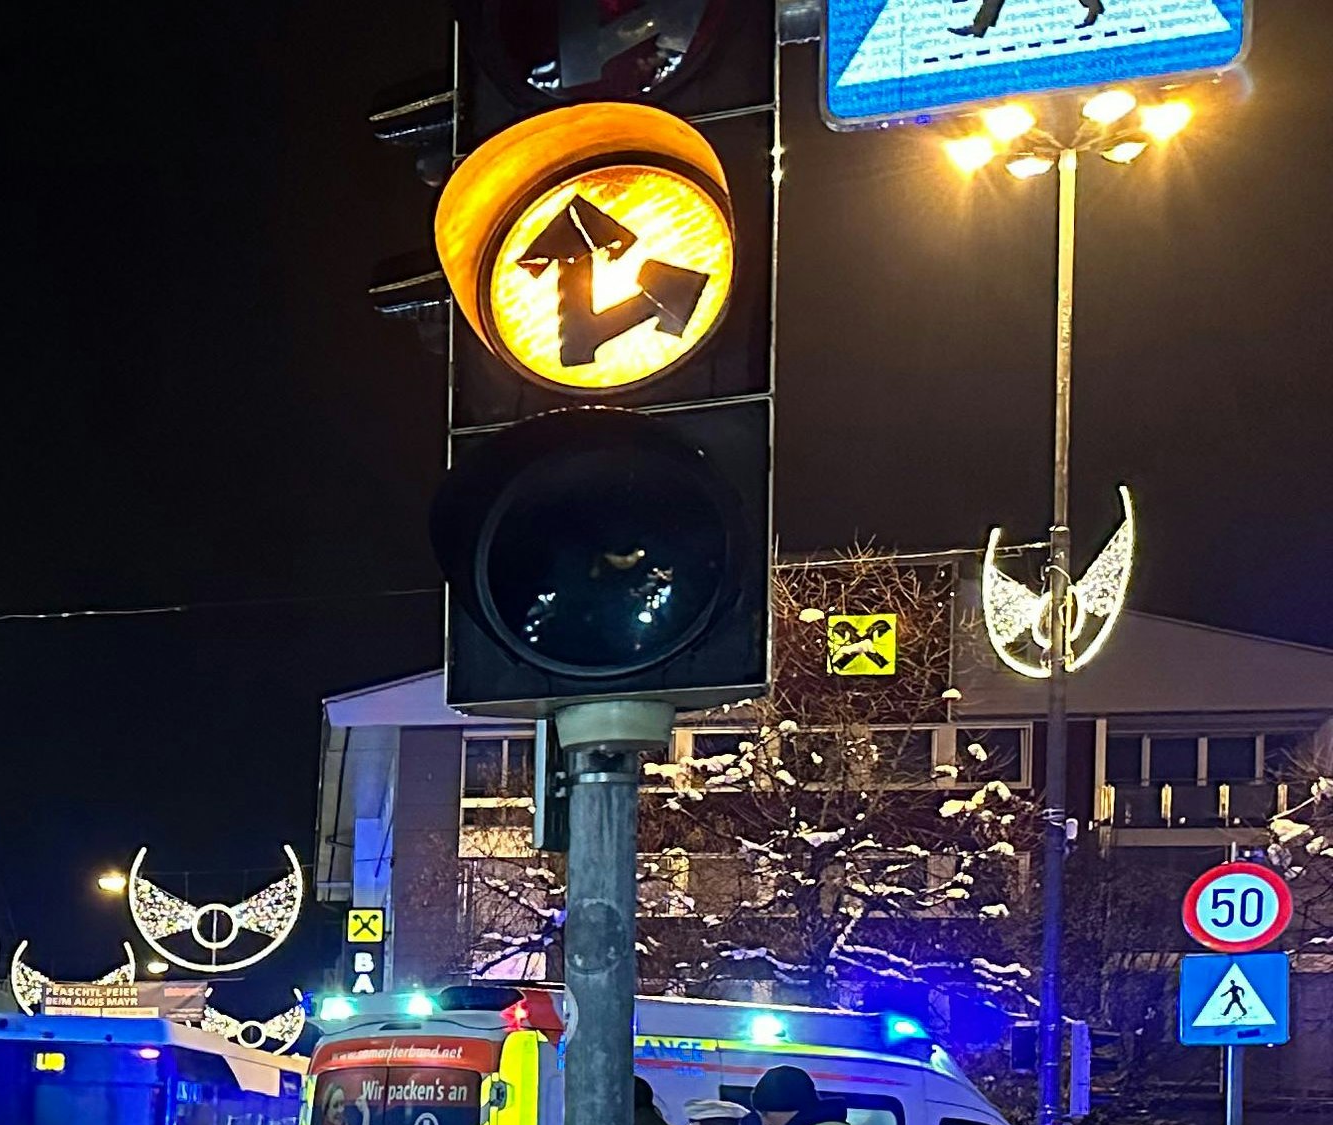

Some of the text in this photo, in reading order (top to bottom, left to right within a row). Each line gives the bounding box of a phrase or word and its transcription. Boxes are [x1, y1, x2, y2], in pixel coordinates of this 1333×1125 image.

[1211, 887, 1264, 928] 50
[361, 1081, 384, 1101] Wir
[448, 1085, 467, 1101] an
